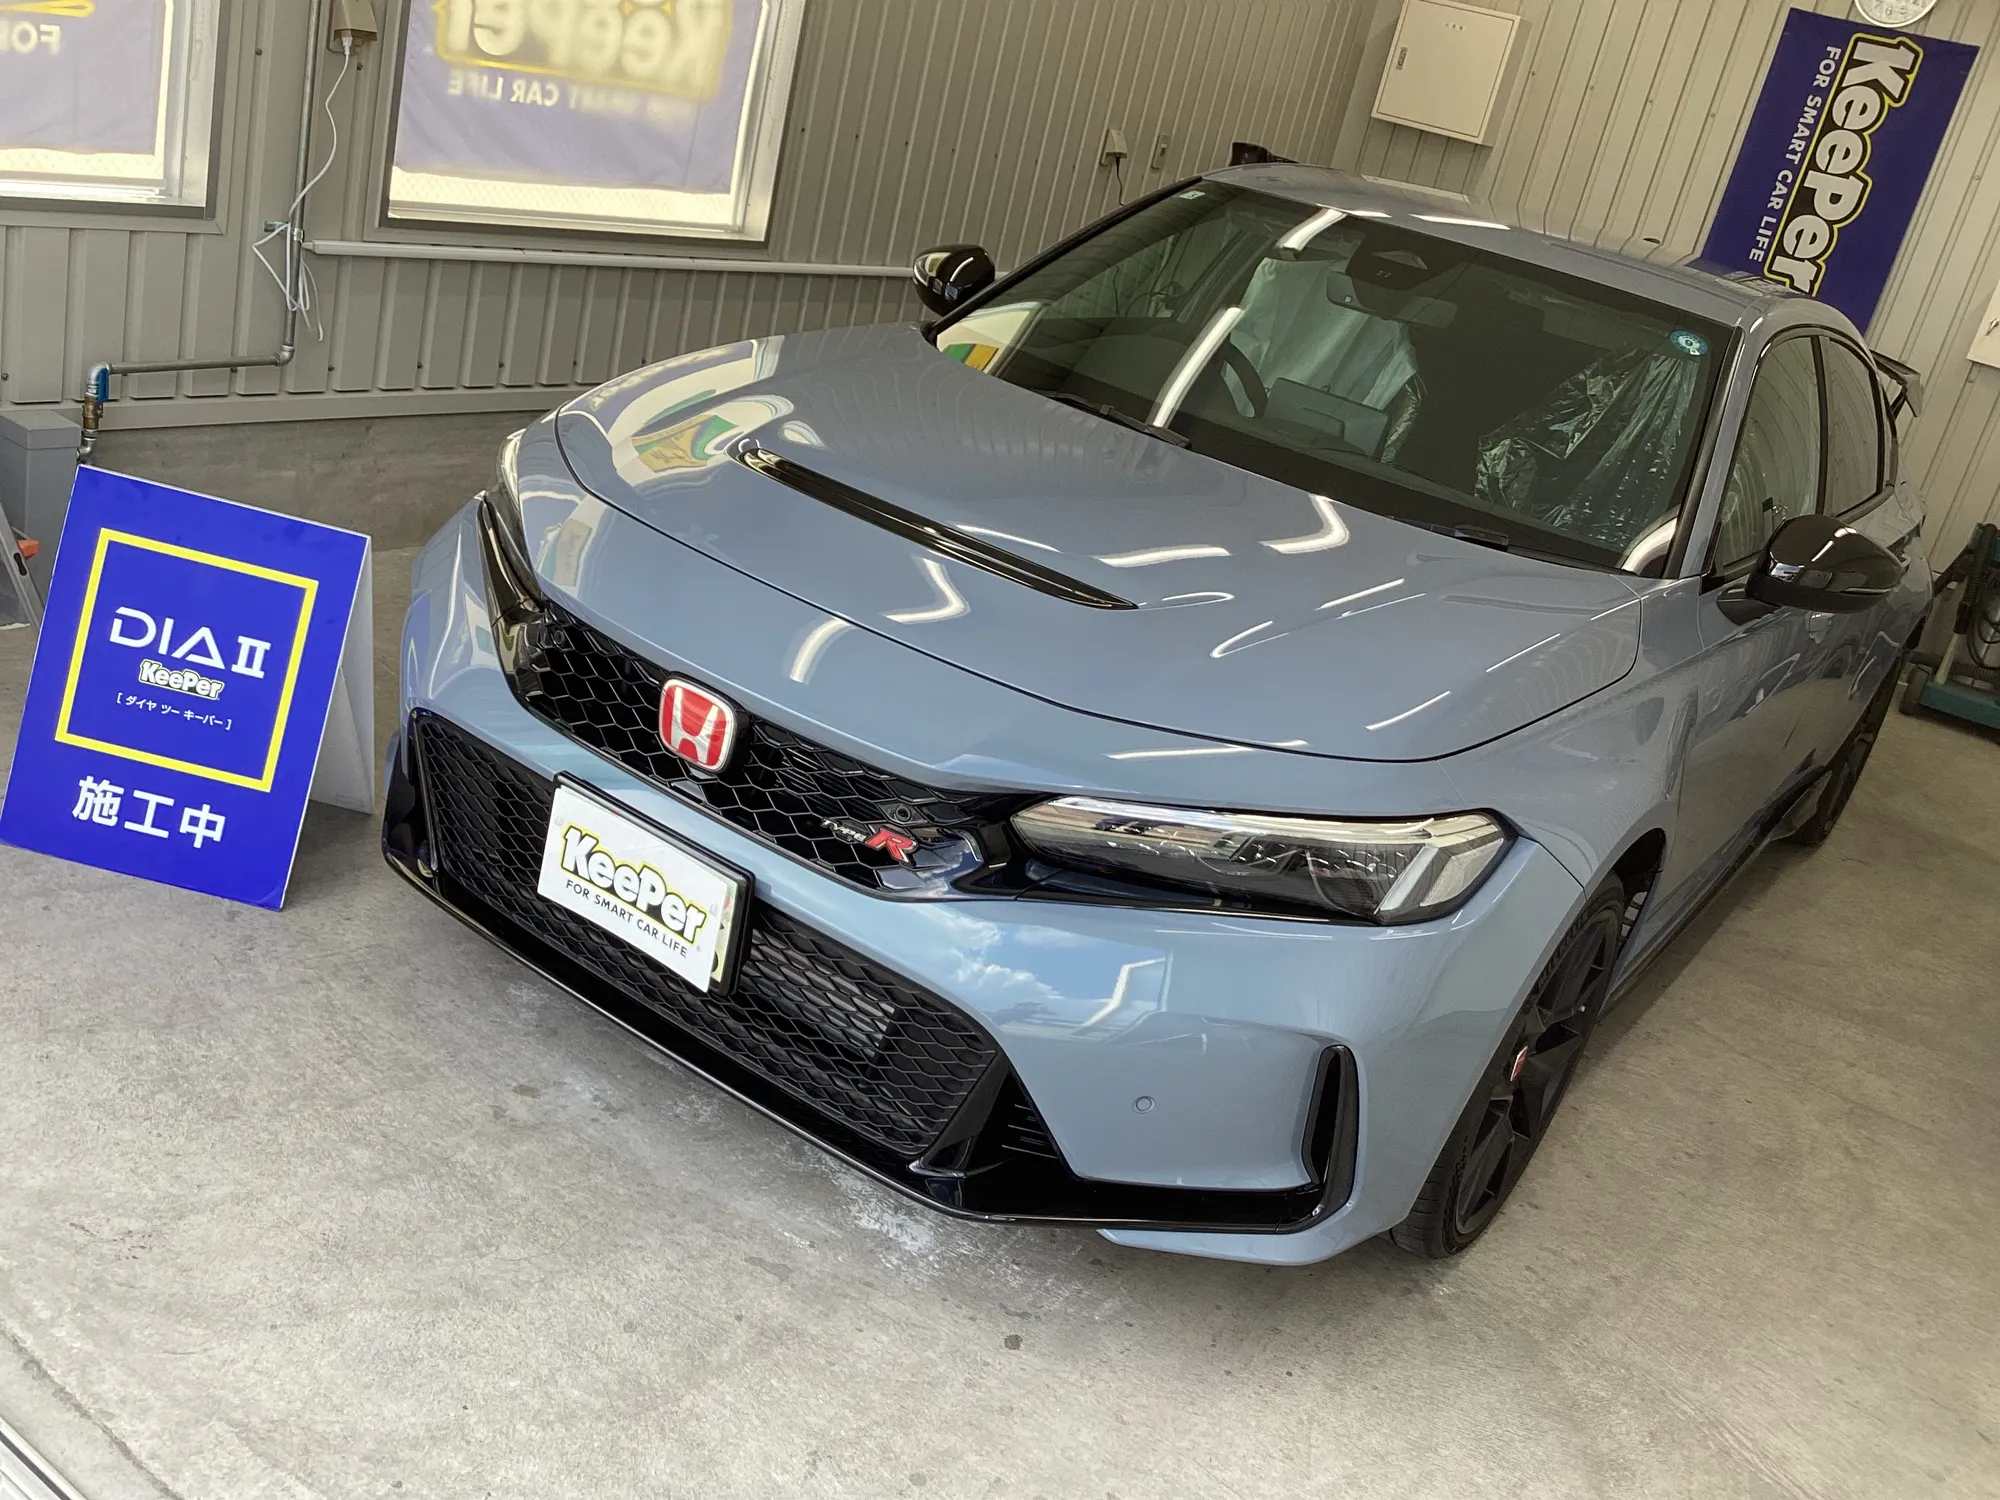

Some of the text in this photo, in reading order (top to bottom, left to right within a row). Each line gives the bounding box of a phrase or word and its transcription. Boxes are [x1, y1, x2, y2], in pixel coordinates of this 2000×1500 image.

[1749, 46, 1842, 262] FOR SMART CAR LIFE
[1772, 41, 1916, 293] KeePer
[139, 658, 224, 699] KeePer
[72, 776, 226, 849] 施工中
[865, 827, 918, 863] R
[562, 826, 707, 944] KeePer
[566, 879, 688, 958] FOR SMART CAR LIFE
